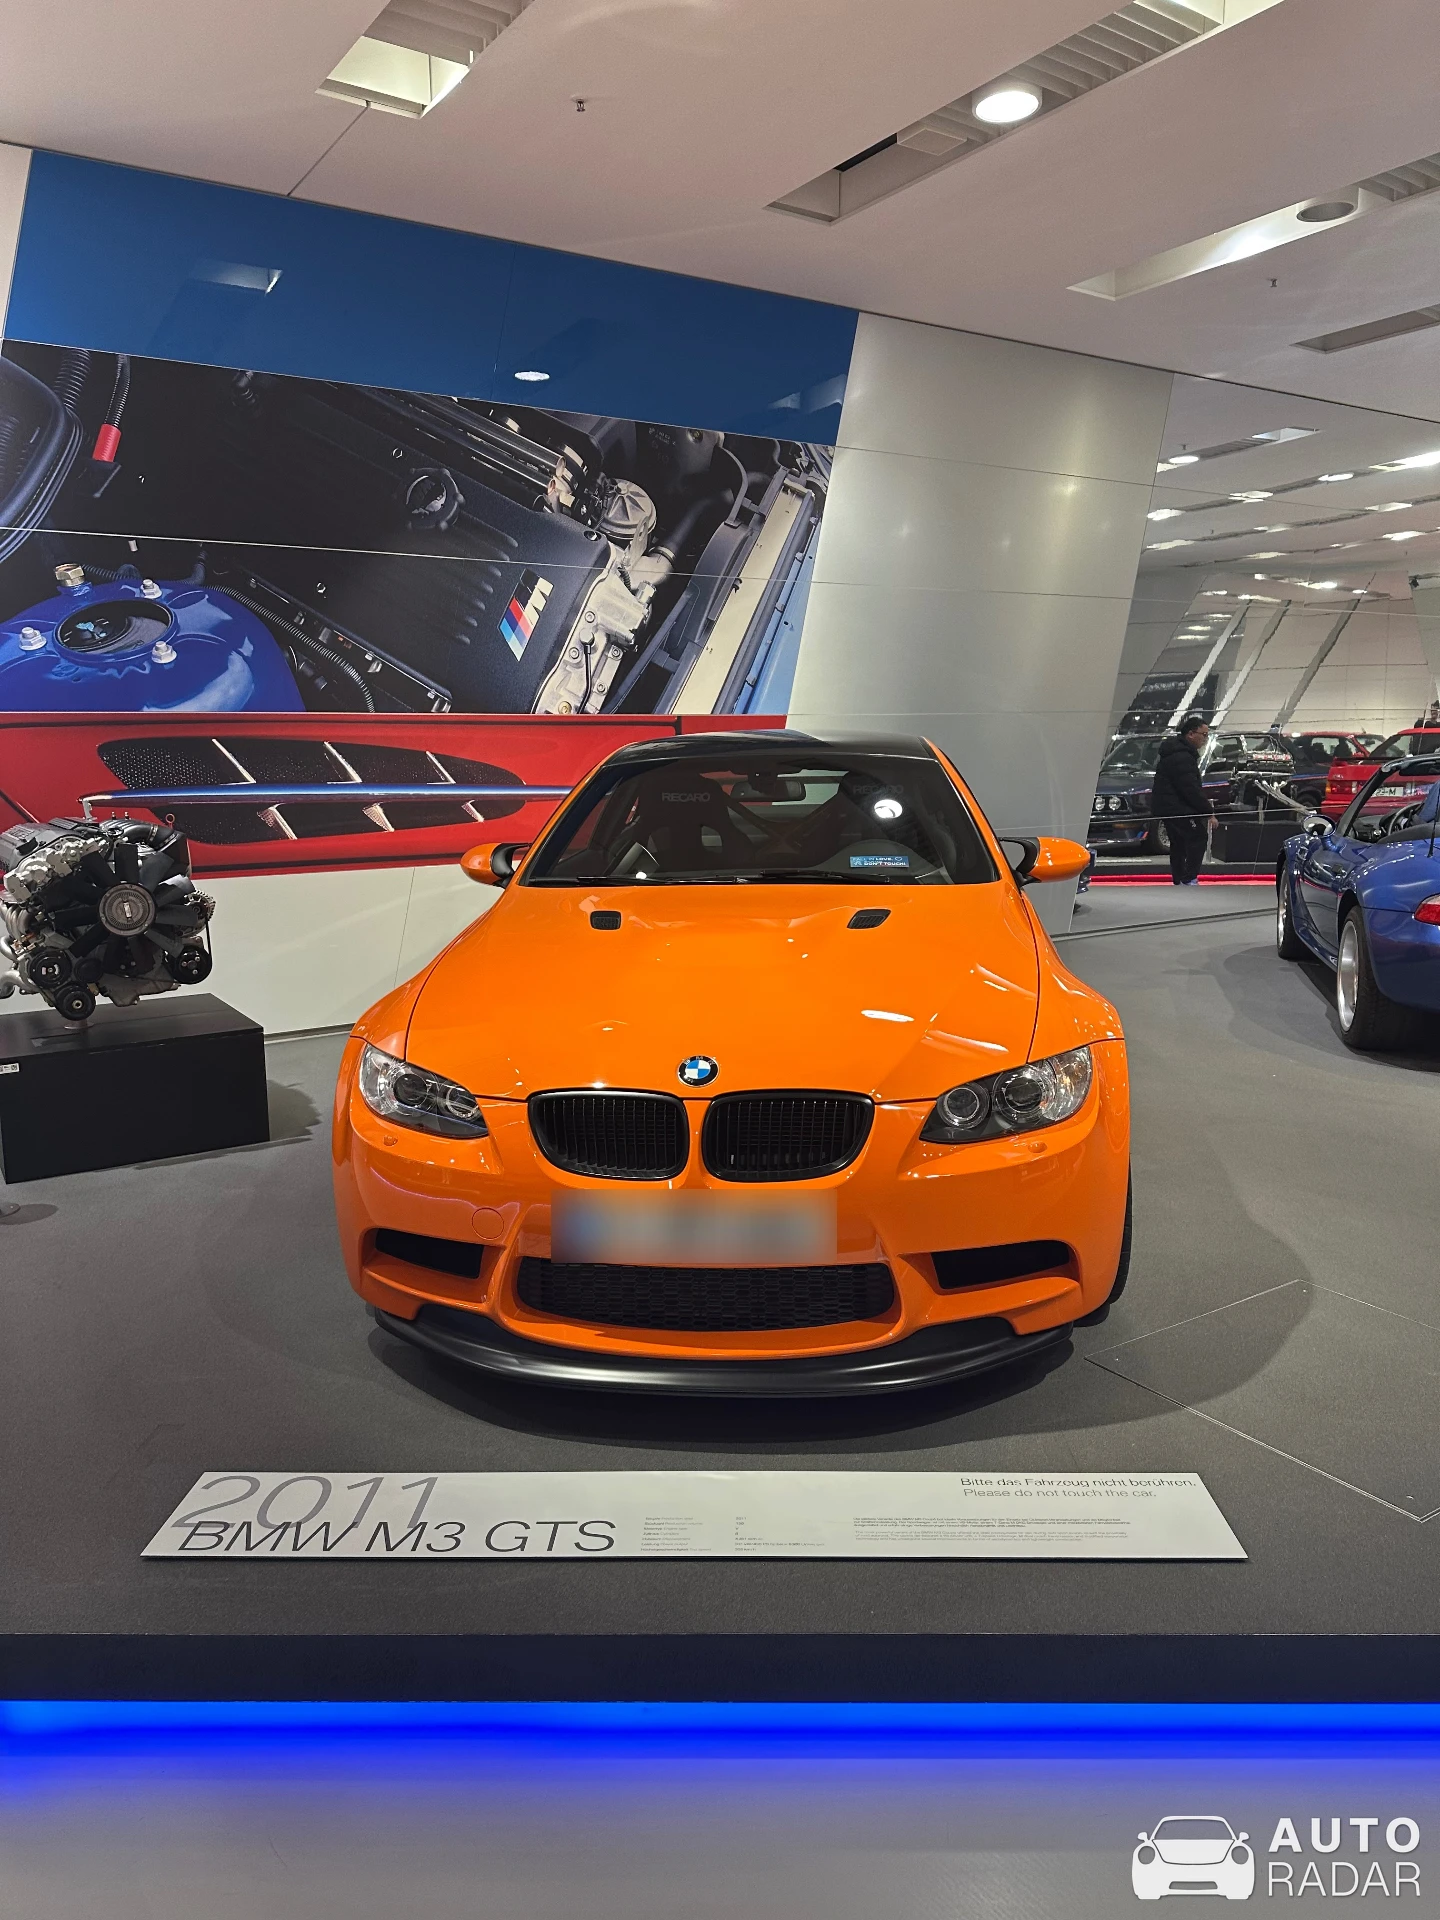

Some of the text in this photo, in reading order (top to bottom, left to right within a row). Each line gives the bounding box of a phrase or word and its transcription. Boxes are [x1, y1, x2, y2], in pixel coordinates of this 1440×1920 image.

[661, 792, 711, 802] RECARO
[960, 1478, 1197, 1488] Bitte das Fahrzeug nicht berühren.
[963, 1488, 1011, 1497] Please
[1014, 1488, 1033, 1497] do
[1036, 1489, 1059, 1497] not
[1062, 1489, 1103, 1497] touch
[1105, 1489, 1129, 1497] the
[171, 1475, 438, 1530] 2011
[178, 1520, 616, 1553] BMW M3 GTS
